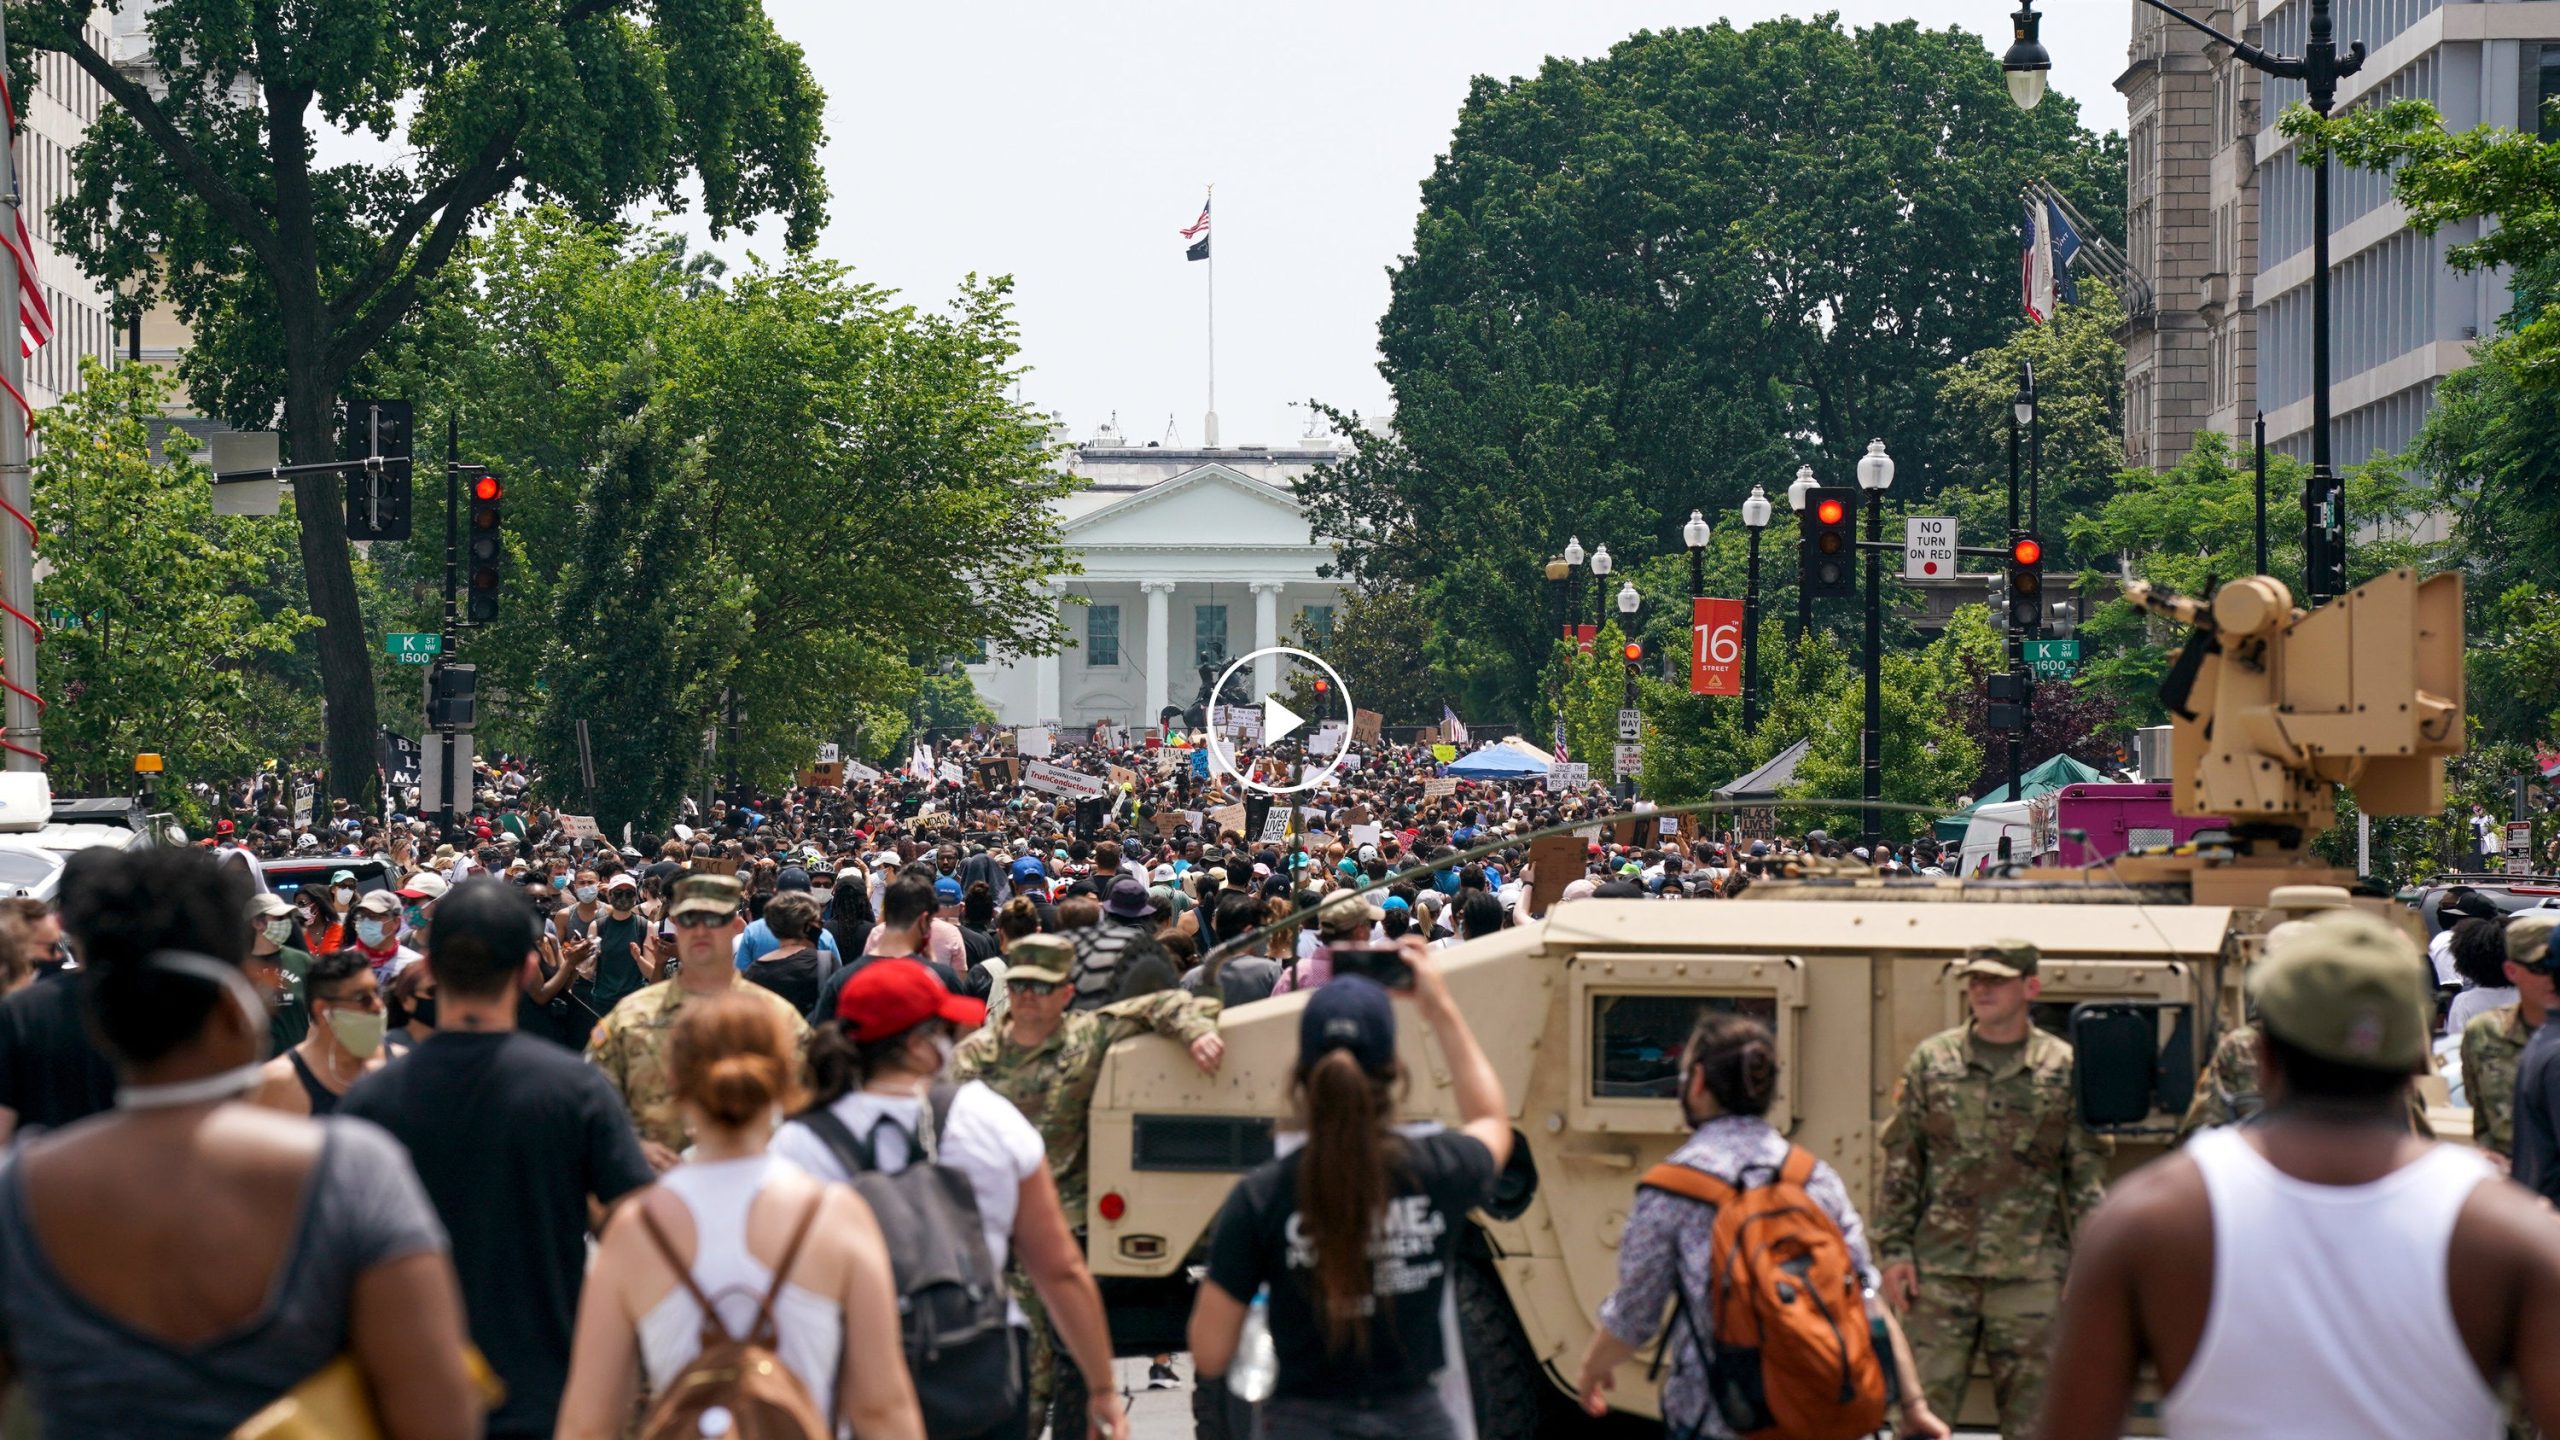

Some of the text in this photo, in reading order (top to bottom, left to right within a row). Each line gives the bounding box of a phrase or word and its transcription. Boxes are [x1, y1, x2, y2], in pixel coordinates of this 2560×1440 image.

[1921, 522, 1942, 533] NO
[1917, 537, 1946, 546] TURN
[1910, 549, 1951, 559] ON RED
[403, 636, 416, 650] K
[1695, 624, 1738, 663] 16
[2039, 644, 2051, 658] K
[400, 653, 429, 663] 1500
[2035, 660, 2066, 670] 1600
[1621, 711, 1639, 719] ONE
[1621, 720, 1639, 728] WAY
[1354, 726, 1378, 744] BLM
[1049, 769, 1082, 782] DOWNLOAD
[1030, 770, 1097, 795] TruthConductor.tv
[1269, 809, 1289, 819] BLACK
[1743, 808, 1774, 819] BLACK
[924, 813, 947, 826] VIDAS
[1744, 819, 1773, 831] LIVES
[1265, 820, 1286, 831] LIVES
[1262, 831, 1284, 840] MATTER
[1742, 829, 1775, 839] MATTER
